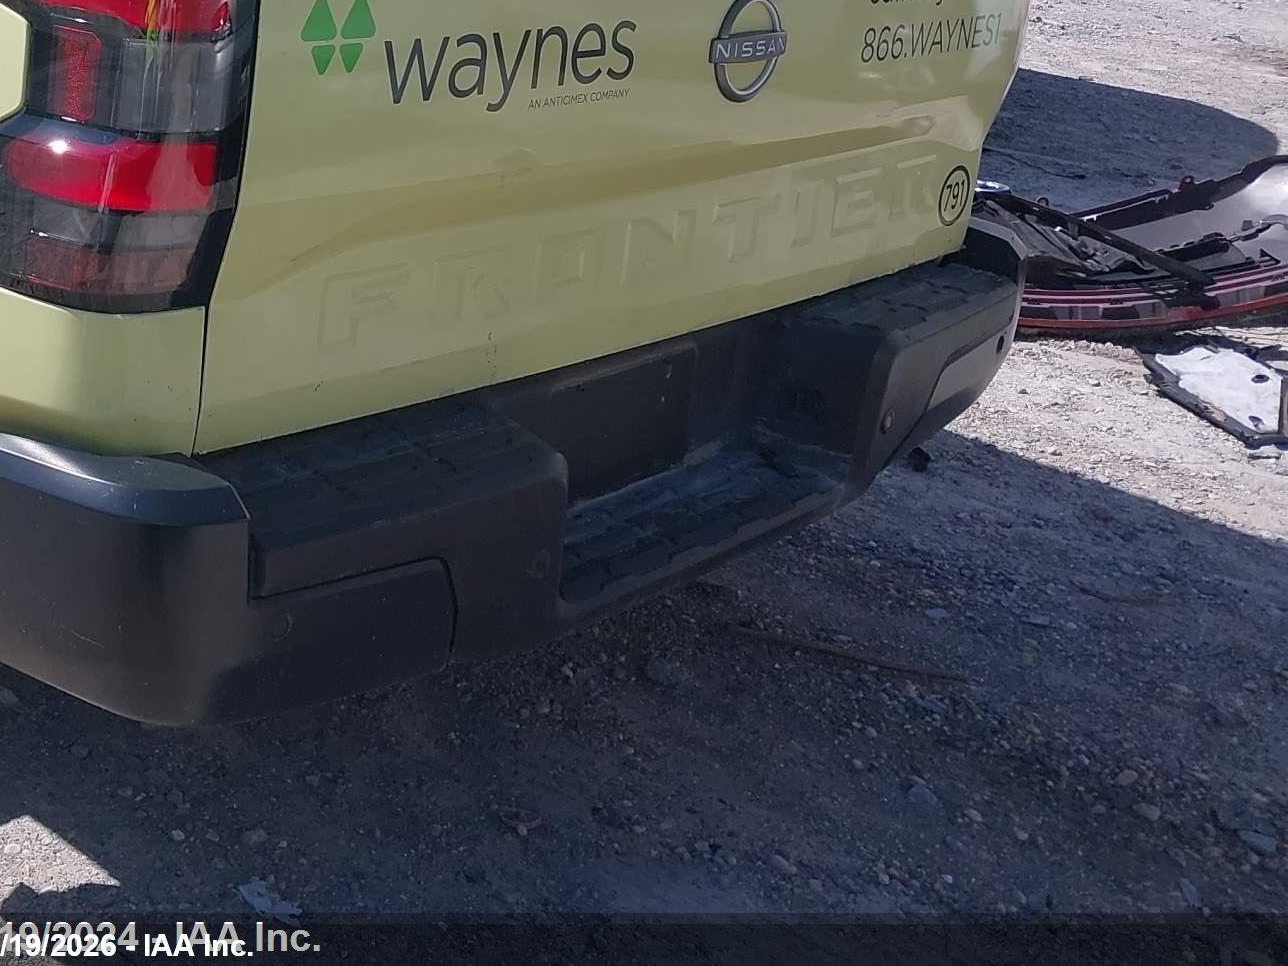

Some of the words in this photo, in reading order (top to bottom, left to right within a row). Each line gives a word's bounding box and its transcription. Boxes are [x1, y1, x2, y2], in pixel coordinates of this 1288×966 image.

[715, 35, 786, 60] NISSAN
[860, 12, 1002, 64] 866.WAYNES1
[383, 19, 638, 112] waynes
[528, 98, 541, 110] AN
[542, 93, 588, 108] ANTICIMEX
[590, 88, 630, 102] COMPANY
[943, 179, 966, 212] 791
[317, 153, 938, 348] FRONTIER
